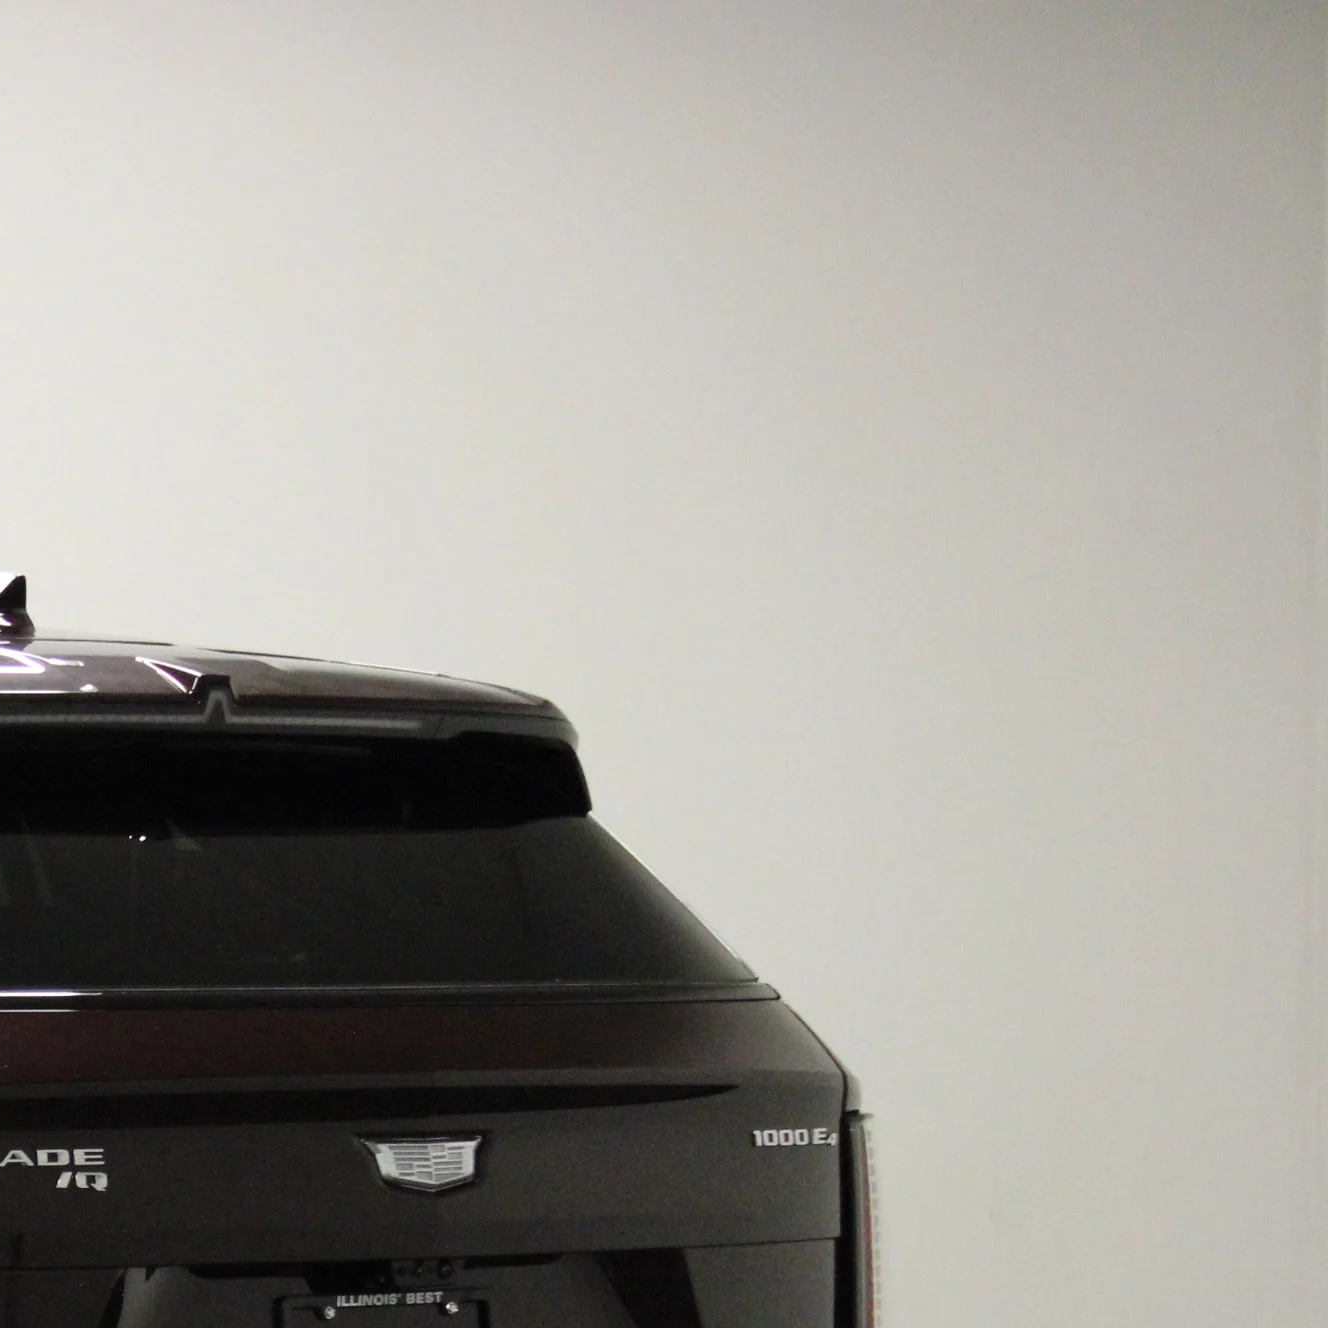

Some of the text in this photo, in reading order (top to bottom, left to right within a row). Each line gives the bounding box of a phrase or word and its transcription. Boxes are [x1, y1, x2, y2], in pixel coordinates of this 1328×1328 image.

[753, 1129, 809, 1146] 1000
[56, 1170, 109, 1192] IQ
[405, 1291, 444, 1305] BEST
